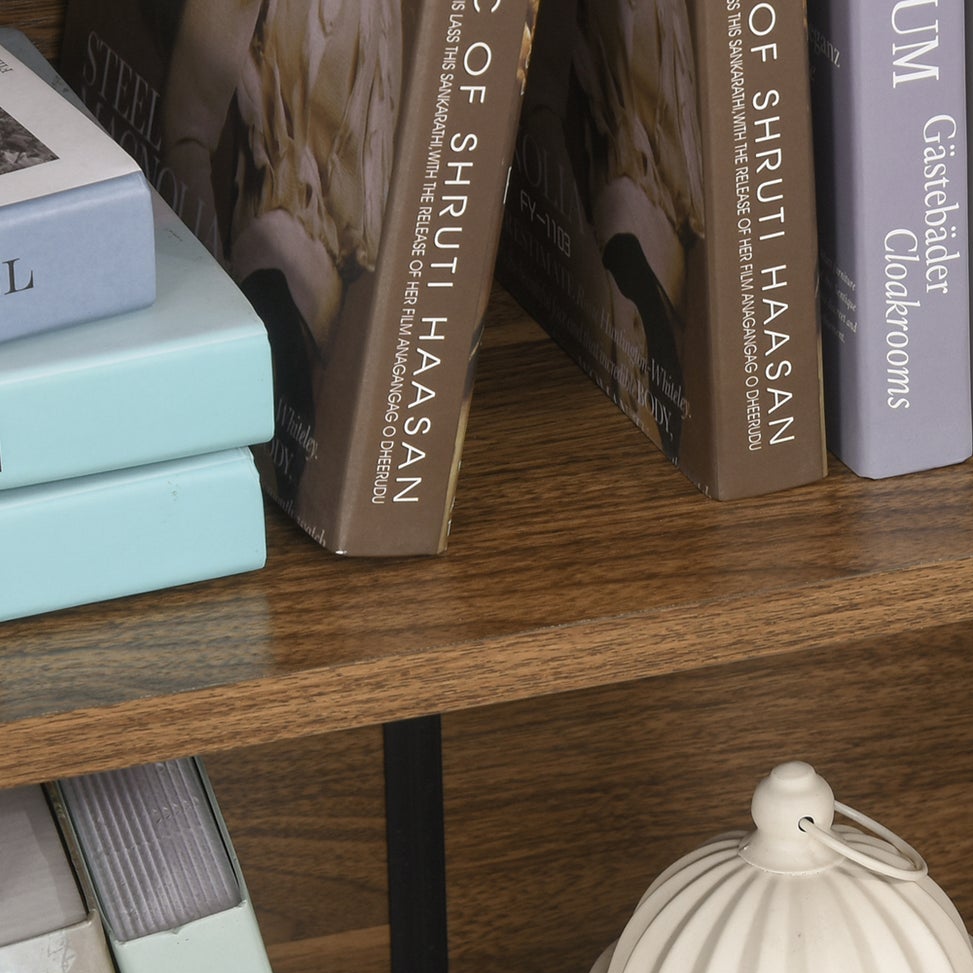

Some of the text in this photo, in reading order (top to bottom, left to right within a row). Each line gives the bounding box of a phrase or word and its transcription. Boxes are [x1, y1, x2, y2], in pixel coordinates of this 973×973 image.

[446, 14, 463, 43] LASS
[728, 12, 742, 37] THIS
[442, 46, 459, 70] THIS
[460, 41, 492, 104] OF
[82, 29, 162, 152] STEEL
[734, 142, 748, 164] THE
[420, 182, 436, 203] THE
[735, 168, 750, 216] RELEASE
[923, 114, 961, 294] Gästebäder
[427, 132, 478, 287] SHRUTI
[748, 2, 795, 445] OF SHRUTI HAASAN
[411, 206, 432, 256] RELEASE
[737, 218, 752, 235] OF
[738, 238, 753, 262] HER
[409, 259, 423, 277] OF
[740, 264, 754, 291] FILM
[404, 281, 420, 305] HER
[398, 308, 415, 335] FILM
[884, 228, 921, 409] Cloakrooms
[745, 375, 759, 387] O
[393, 317, 448, 502] HAASAN
[746, 389, 762, 451] DHEERUDU
[382, 425, 396, 438] O
[371, 439, 394, 504] DHEERUDU
